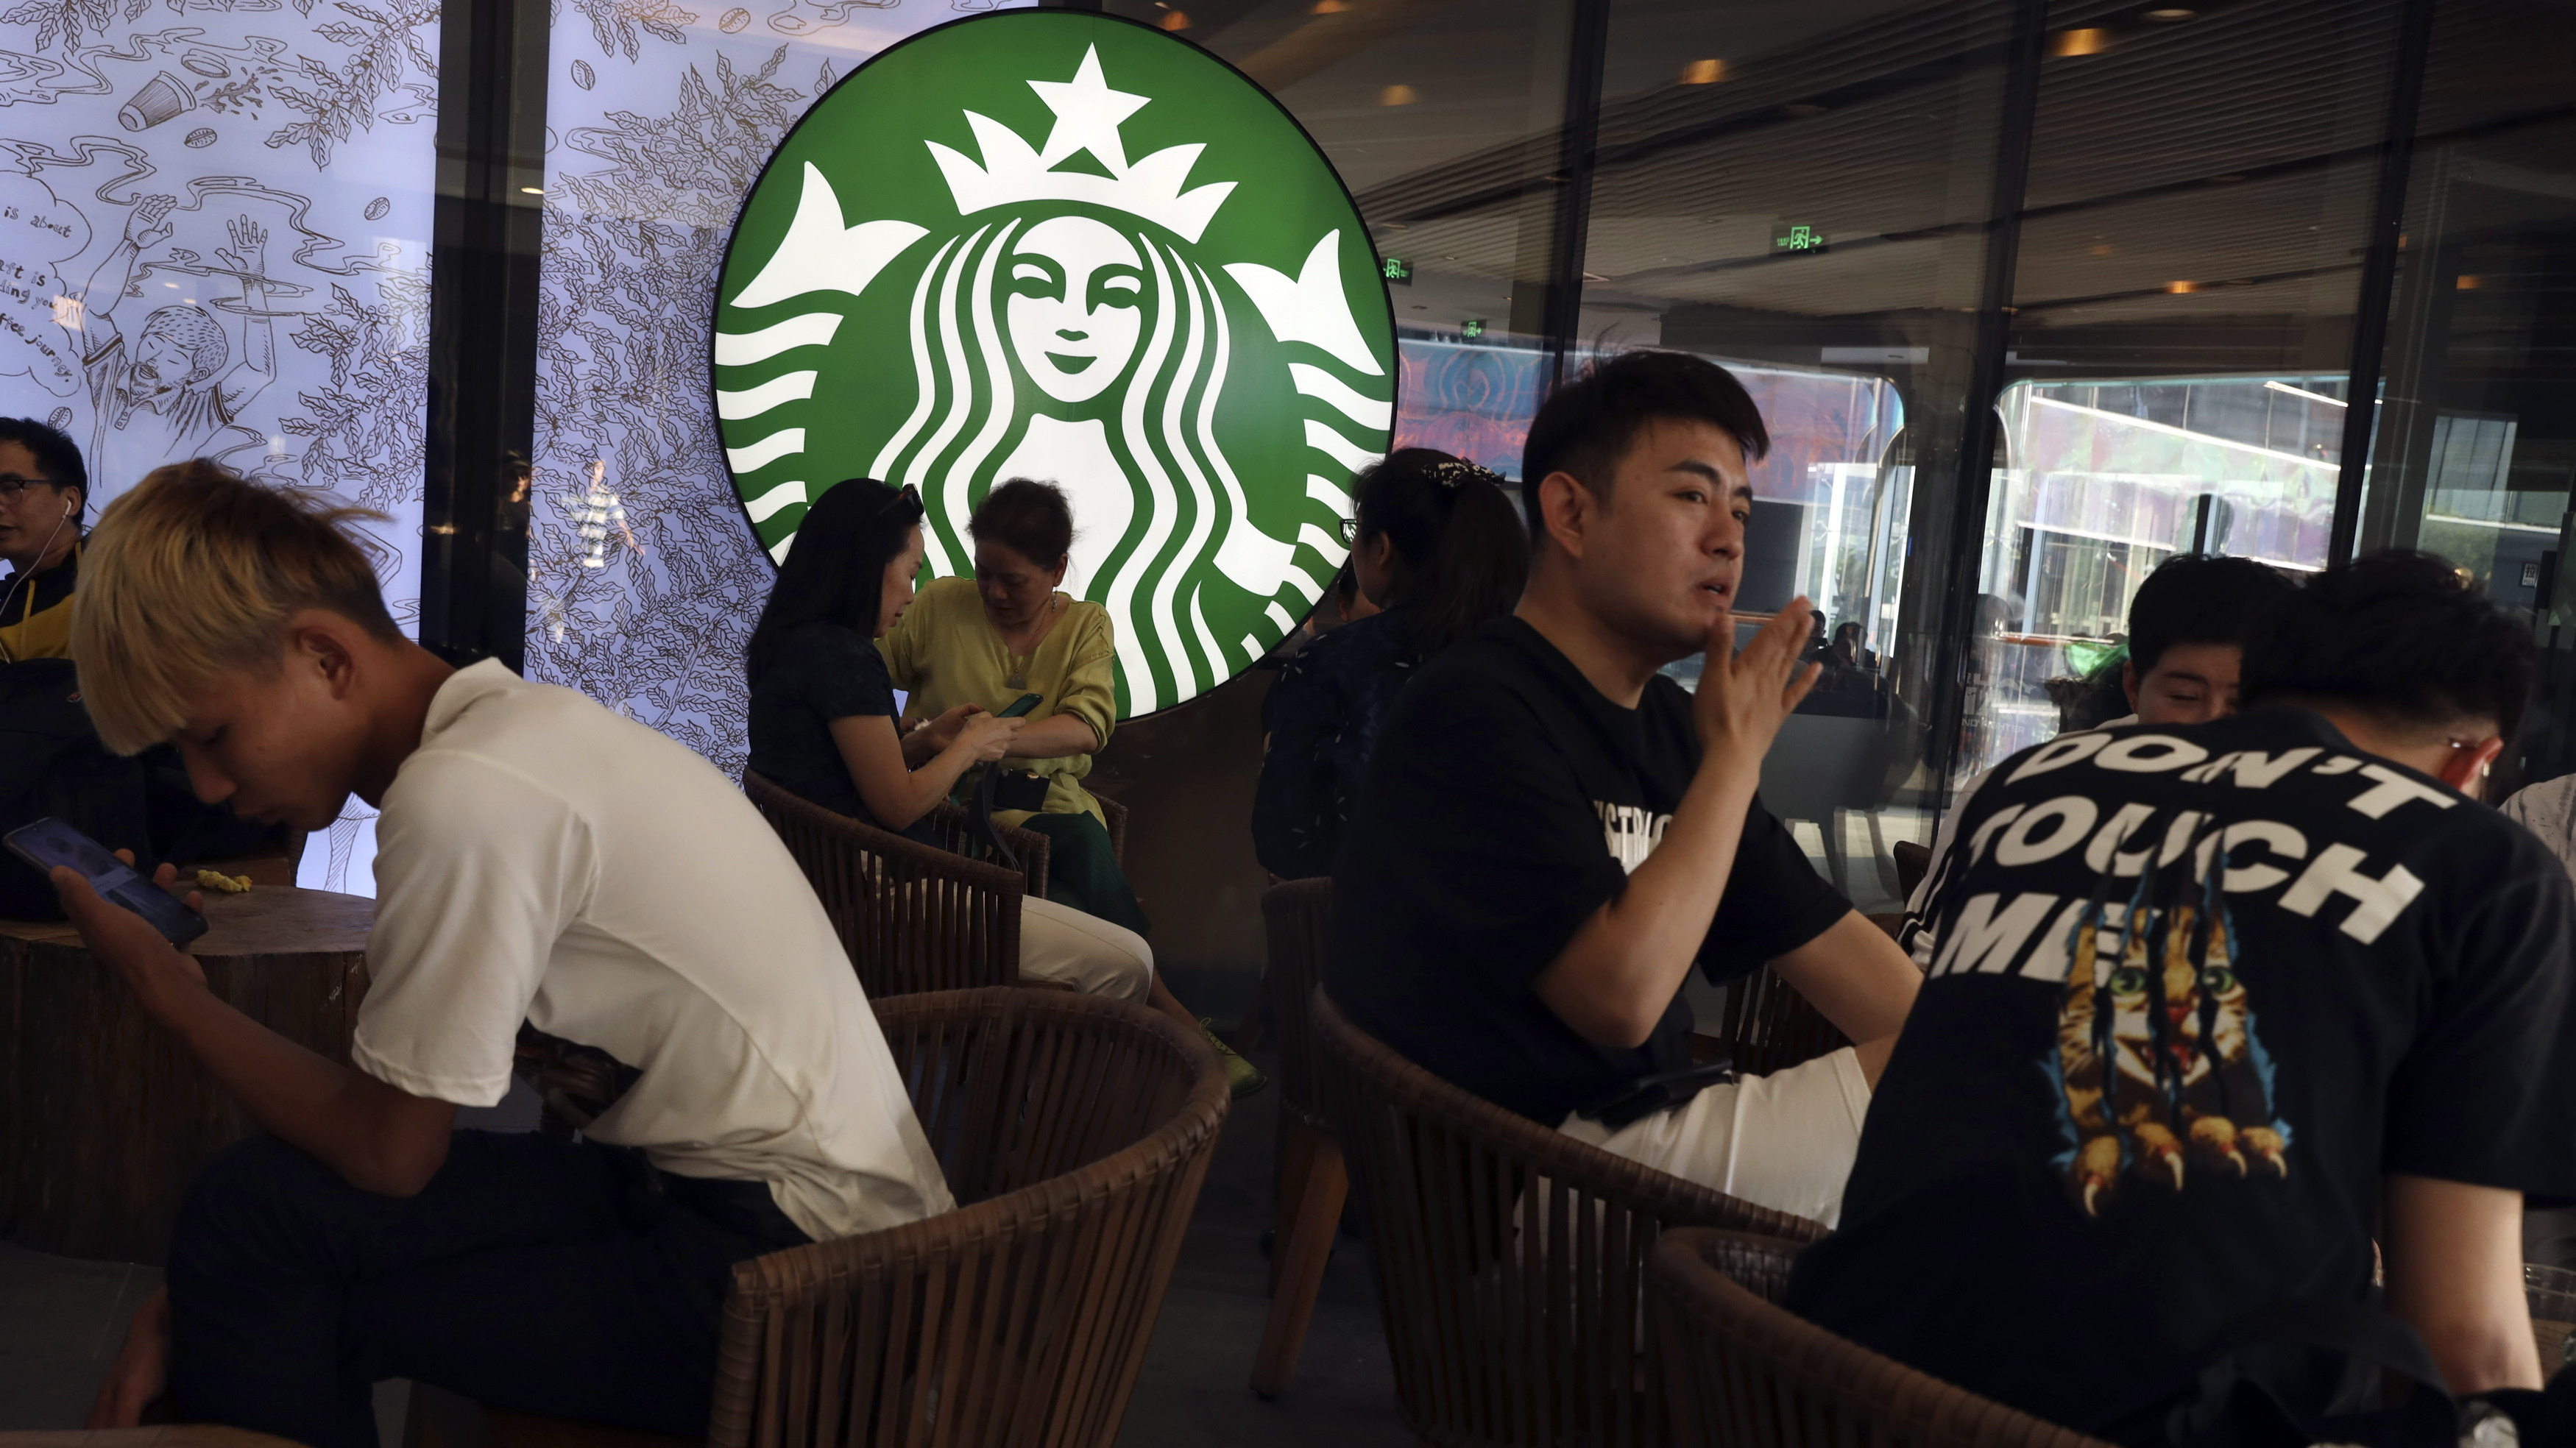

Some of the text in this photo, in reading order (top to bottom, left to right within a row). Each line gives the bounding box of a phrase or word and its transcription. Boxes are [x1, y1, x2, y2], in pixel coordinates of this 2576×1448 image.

[4, 206, 72, 238] is about
[31, 271, 46, 287] is
[2004, 733, 2459, 820] DON'T
[1961, 795, 2425, 945] TOUCH
[1929, 891, 2163, 989] ME
